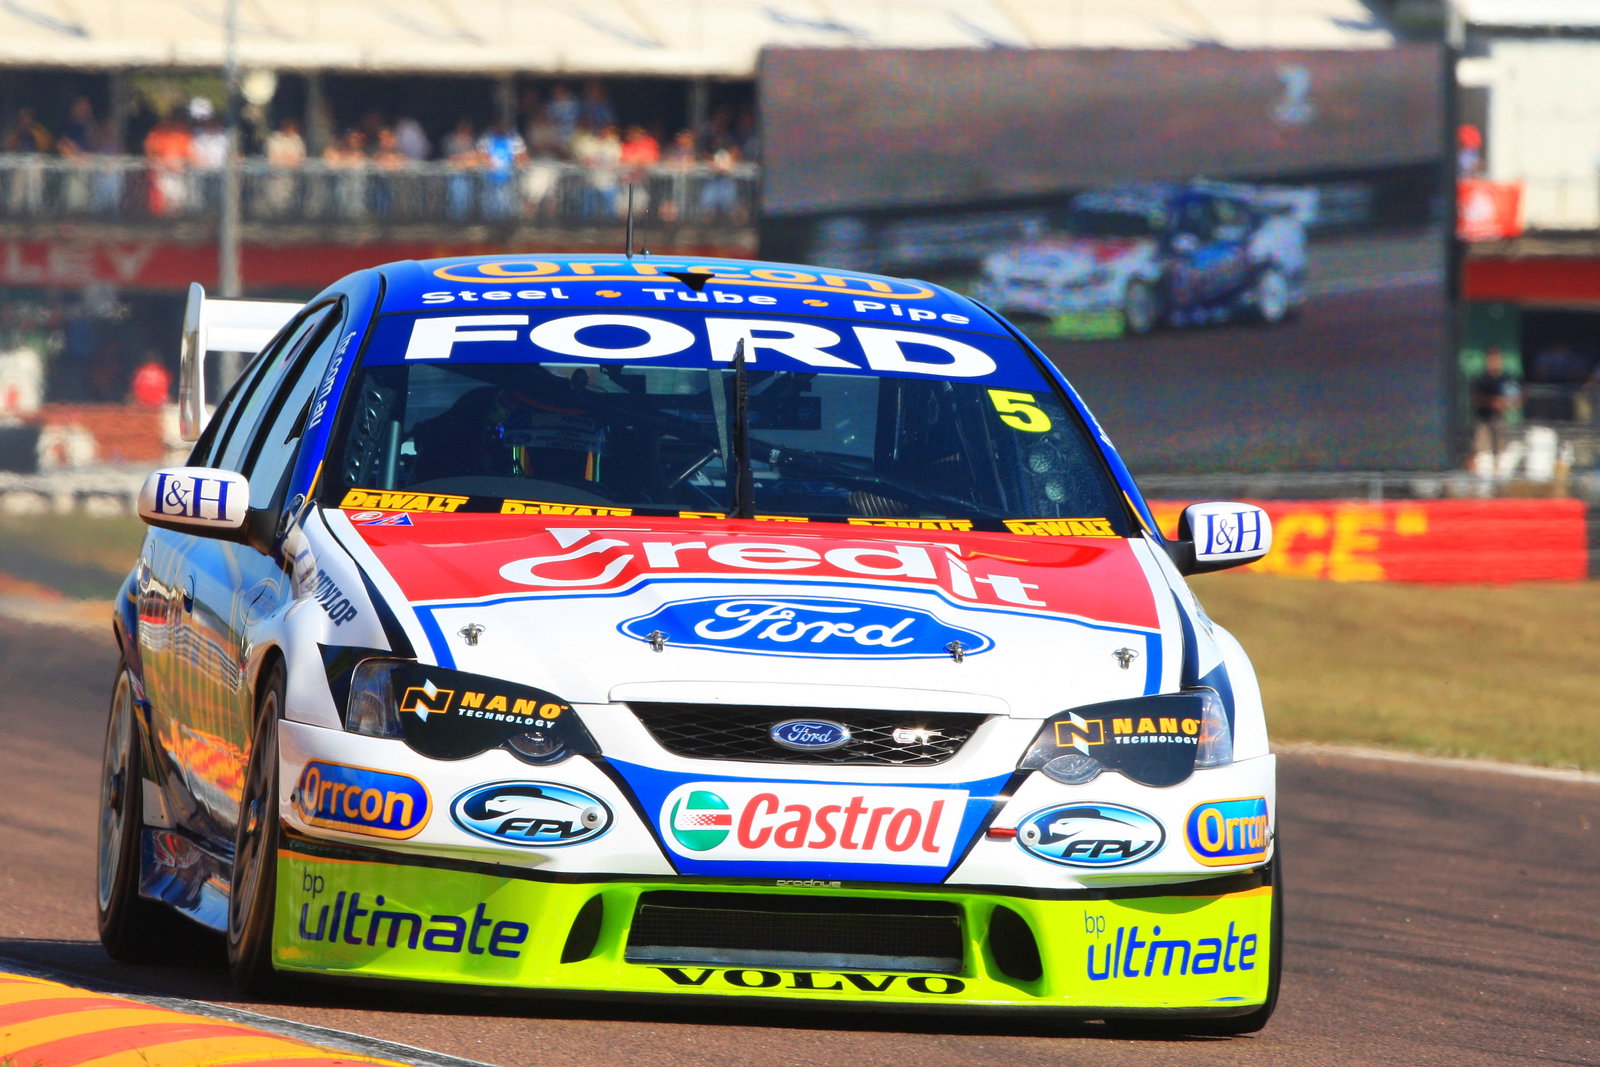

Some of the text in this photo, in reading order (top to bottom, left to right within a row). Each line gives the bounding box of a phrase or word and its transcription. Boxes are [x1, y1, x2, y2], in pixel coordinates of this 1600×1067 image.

[477, 261, 894, 294] Orrcon
[422, 287, 970, 325] Steel Tube Pipe
[404, 313, 997, 378] FORD
[987, 389, 1052, 433] 5
[341, 490, 469, 513] DEWALT
[1005, 519, 1117, 537] DEWALT
[313, 569, 358, 627] DUNLOP
[694, 600, 914, 648] Ford
[458, 708, 555, 729] TECHNOLOGY
[461, 691, 562, 719] NANO
[787, 724, 832, 744] Ford
[892, 728, 942, 746] GT
[1112, 718, 1198, 734] NANO
[1115, 736, 1199, 745] TECHNOLOGY
[304, 769, 414, 828] Orrcon
[494, 817, 594, 839] FPV
[737, 793, 945, 853] Castrol
[1198, 808, 1267, 852] Orrcon
[1061, 838, 1154, 858] FPV
[302, 866, 325, 898] bp
[299, 890, 530, 959] ultimate
[1084, 910, 1106, 938] bp
[1087, 920, 1258, 981] ultimate
[656, 967, 966, 995] VOLVO
